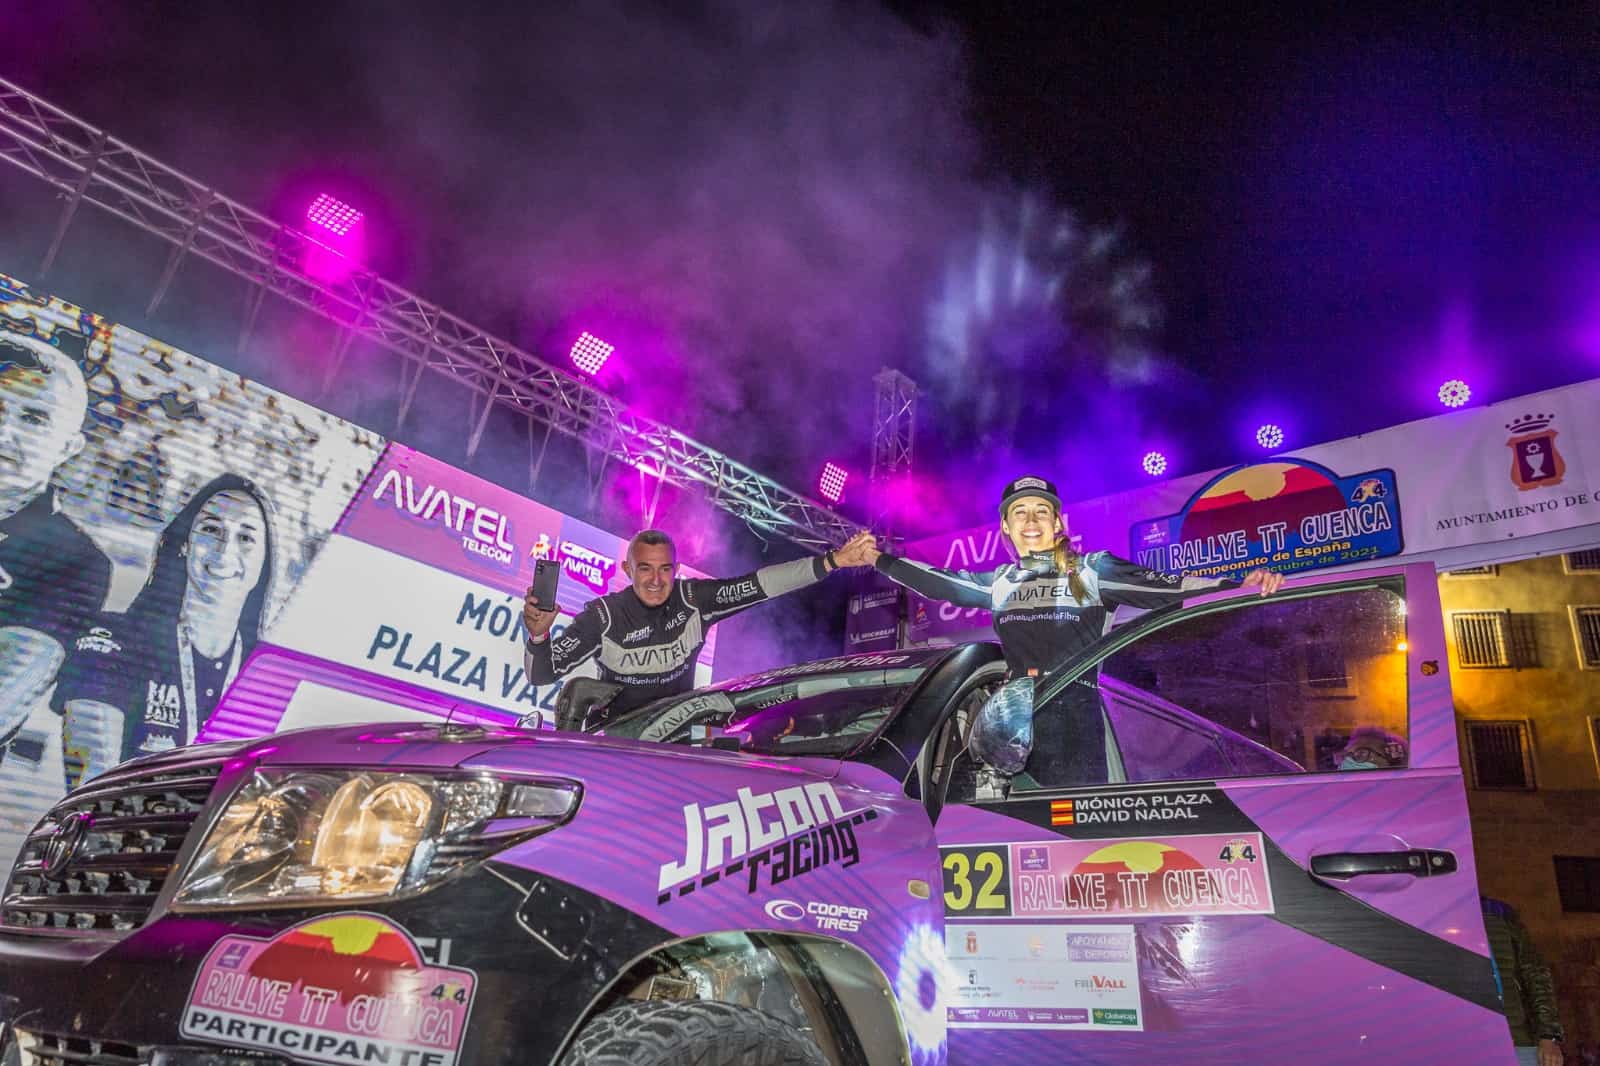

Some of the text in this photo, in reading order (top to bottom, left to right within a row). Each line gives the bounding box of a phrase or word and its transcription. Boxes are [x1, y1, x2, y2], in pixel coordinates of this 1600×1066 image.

[372, 469, 515, 552] AVATEL
[1436, 499, 1558, 531] AYUNTAMIENTO
[1565, 493, 1588, 507] DE
[461, 536, 514, 565] TELECOM
[944, 513, 1083, 567] AVAL
[1169, 529, 1248, 570] RALLYE
[1257, 522, 1288, 553] TT
[1300, 501, 1392, 544] CUENCA
[1317, 555, 1337, 564] de
[1340, 546, 1380, 559] 2021
[1181, 555, 1269, 578] Campeonato
[1272, 550, 1291, 562] de
[1294, 540, 1352, 558] España
[366, 624, 565, 711] PLAZA VAZ
[620, 640, 687, 668] AVATEL
[1074, 793, 1213, 810] MÓNICA PLAZA
[1074, 807, 1198, 825] DAVID NADAL
[747, 819, 861, 895] racing
[943, 851, 1007, 911] 32
[1018, 867, 1259, 911] RALLYE TT CUENCA
[807, 902, 868, 920] COOPER
[815, 916, 862, 932] TIRES
[201, 968, 456, 1047] RALLYE TT CUCA
[189, 1011, 446, 1066] PARTICIPANTE
